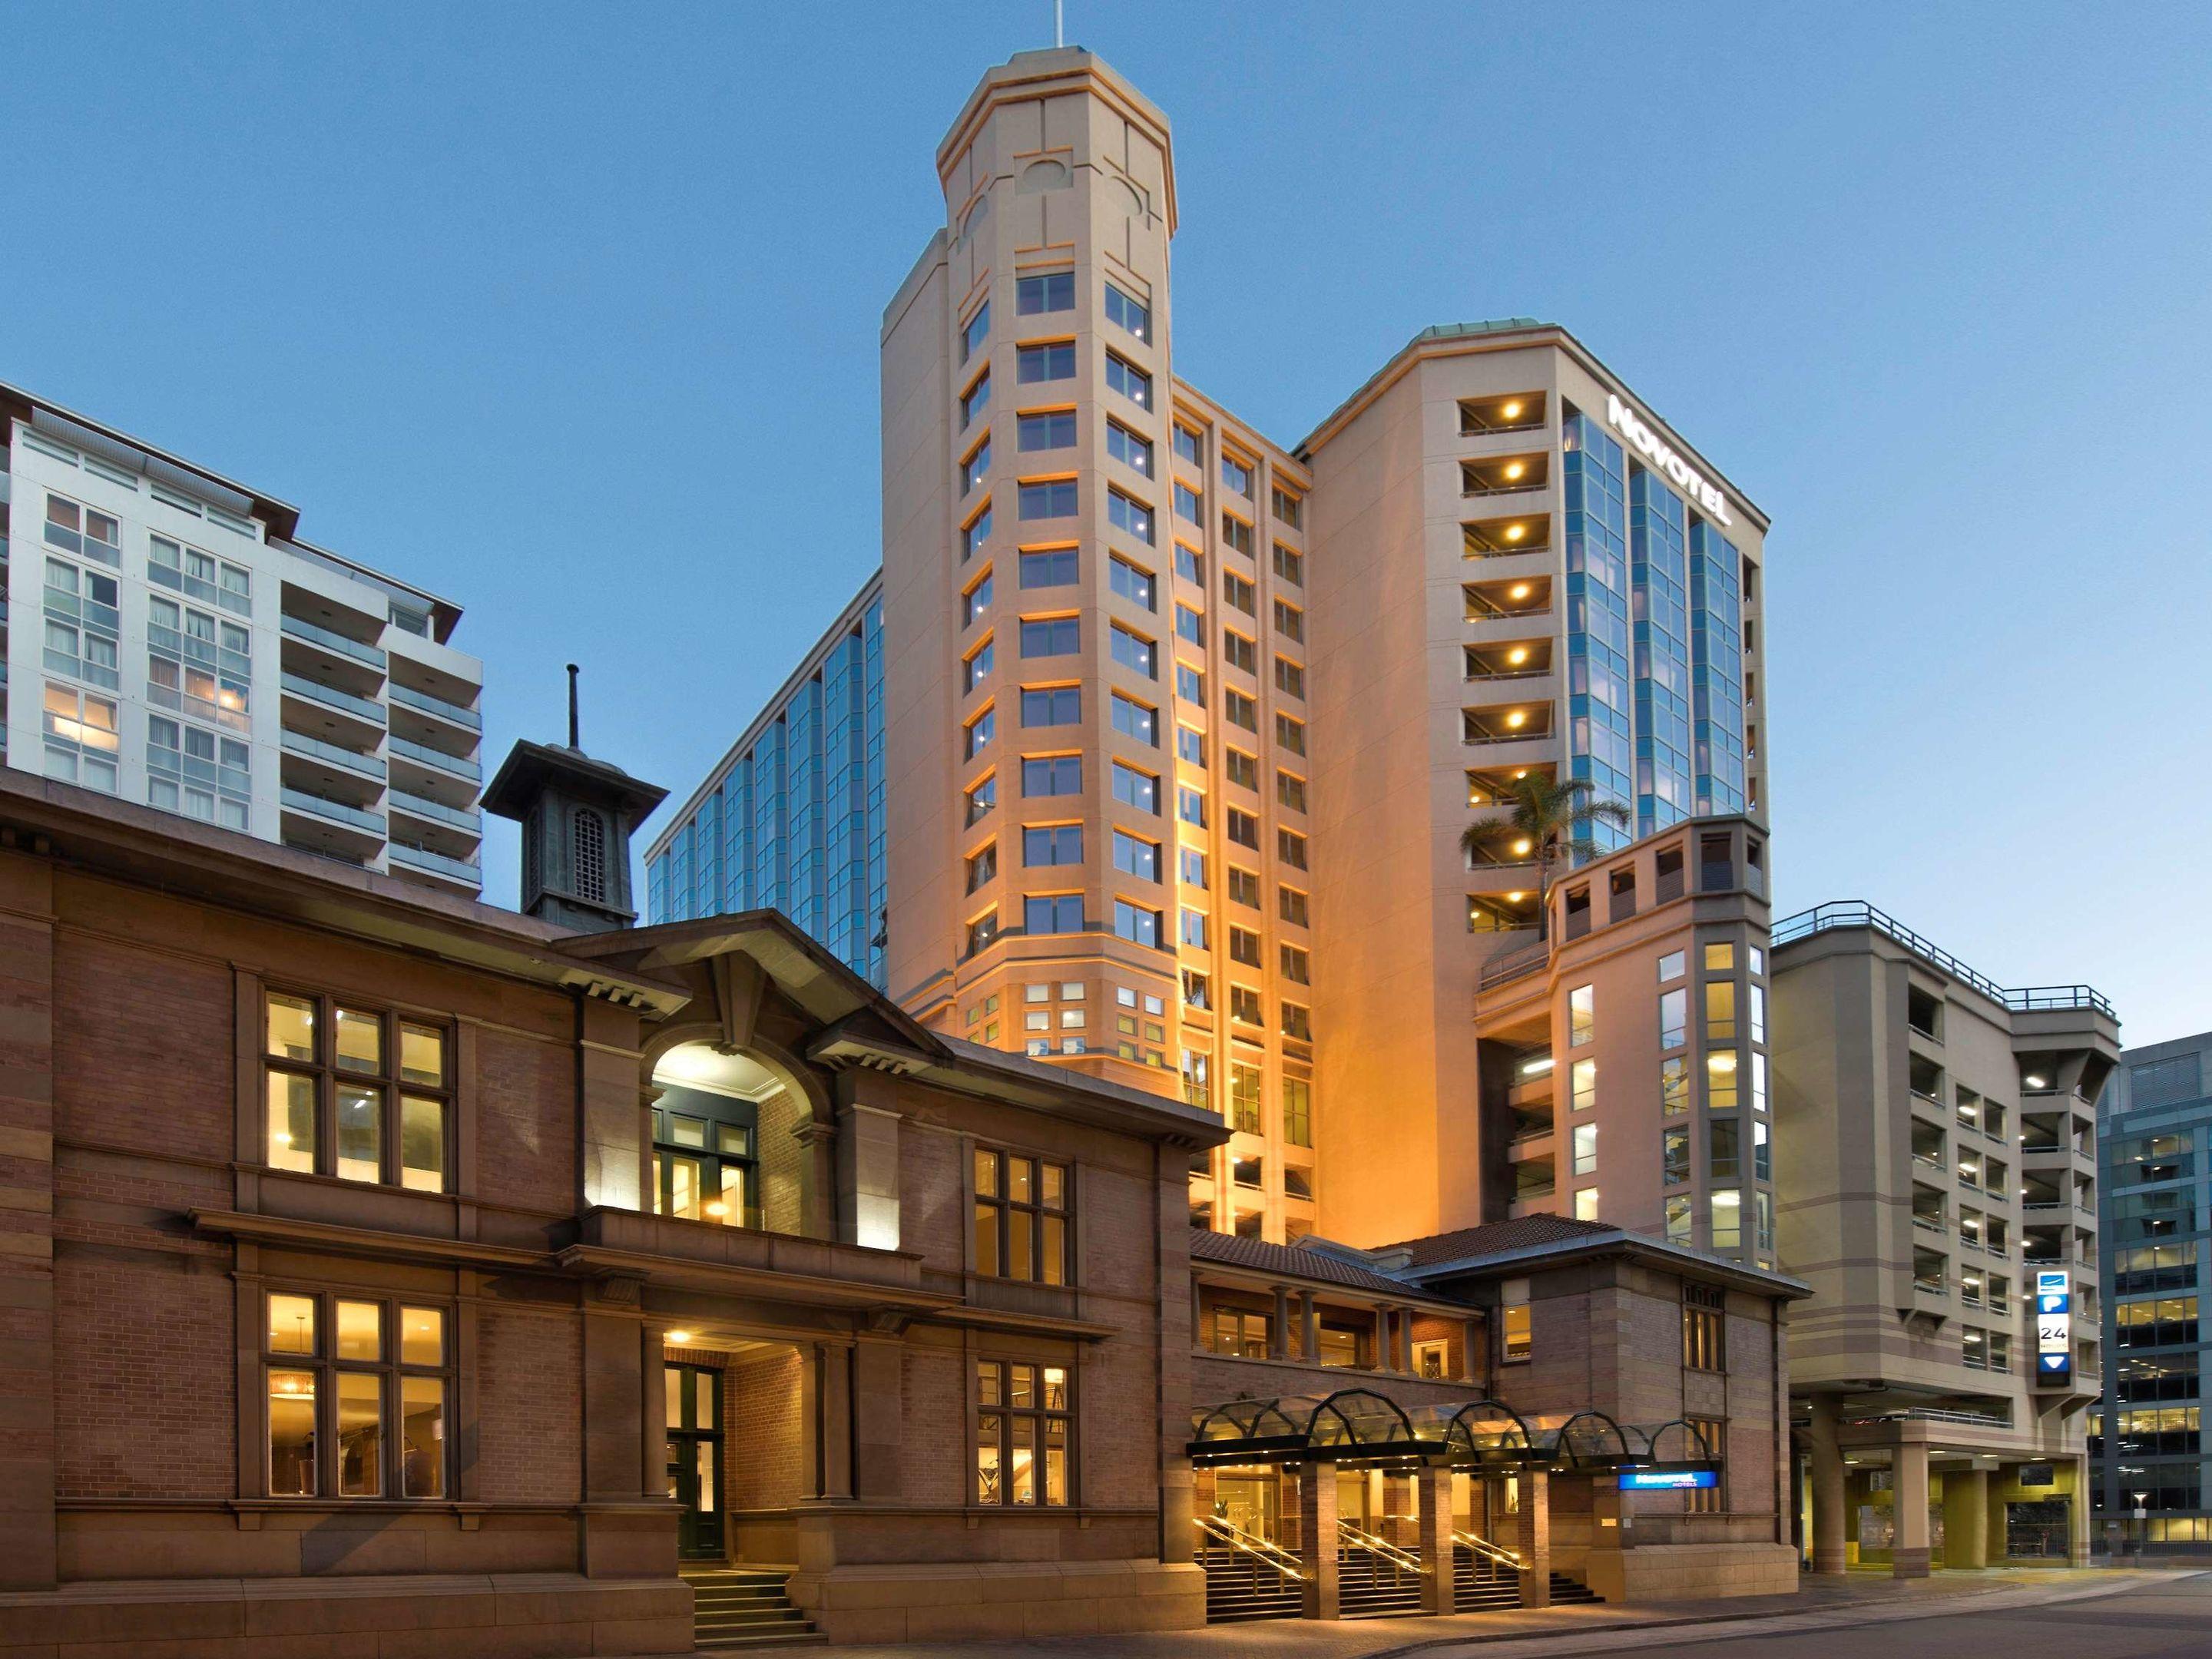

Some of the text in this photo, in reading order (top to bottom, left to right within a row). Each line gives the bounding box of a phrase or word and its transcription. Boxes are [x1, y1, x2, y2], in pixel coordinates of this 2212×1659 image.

[1608, 394, 1731, 525] NOVOTEL
[2043, 1296, 2062, 1312] P
[2041, 1327, 2066, 1339] 24
